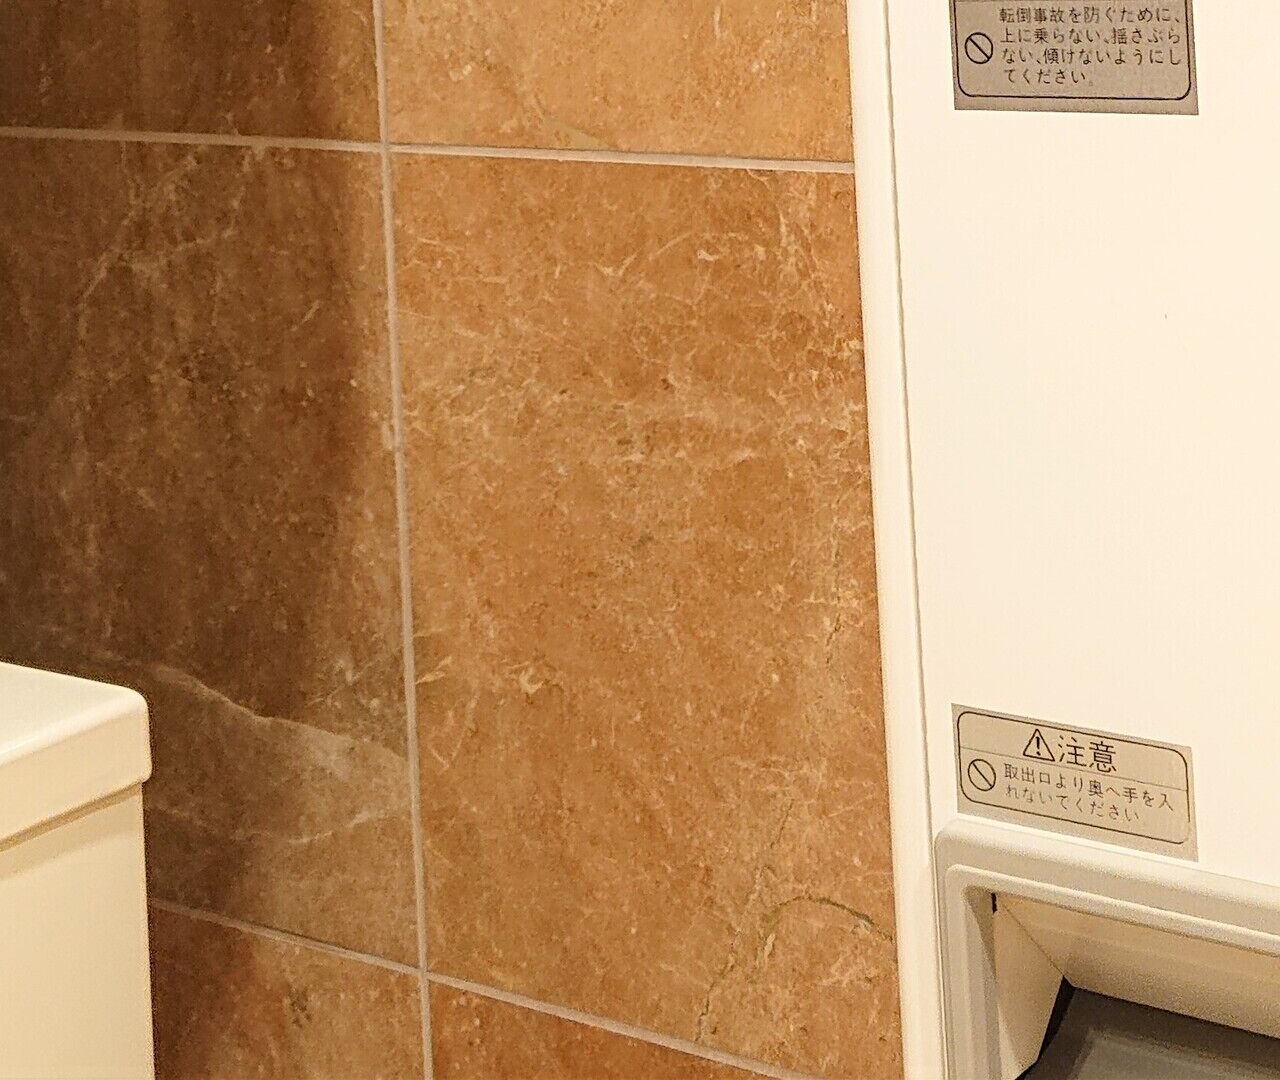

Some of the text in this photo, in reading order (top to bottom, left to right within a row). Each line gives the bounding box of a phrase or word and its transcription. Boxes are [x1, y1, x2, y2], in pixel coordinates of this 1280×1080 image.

[999, 6, 1181, 26] 転倒事故を防ぐために、
[1000, 27, 1181, 45] 上に乗らない、揺さぶら
[1002, 47, 1181, 67] ない、傾けないようにし
[1005, 68, 1094, 87] てください。
[1057, 734, 1116, 774] 注意
[1004, 763, 1174, 812] 取出口より奥へ手を入
